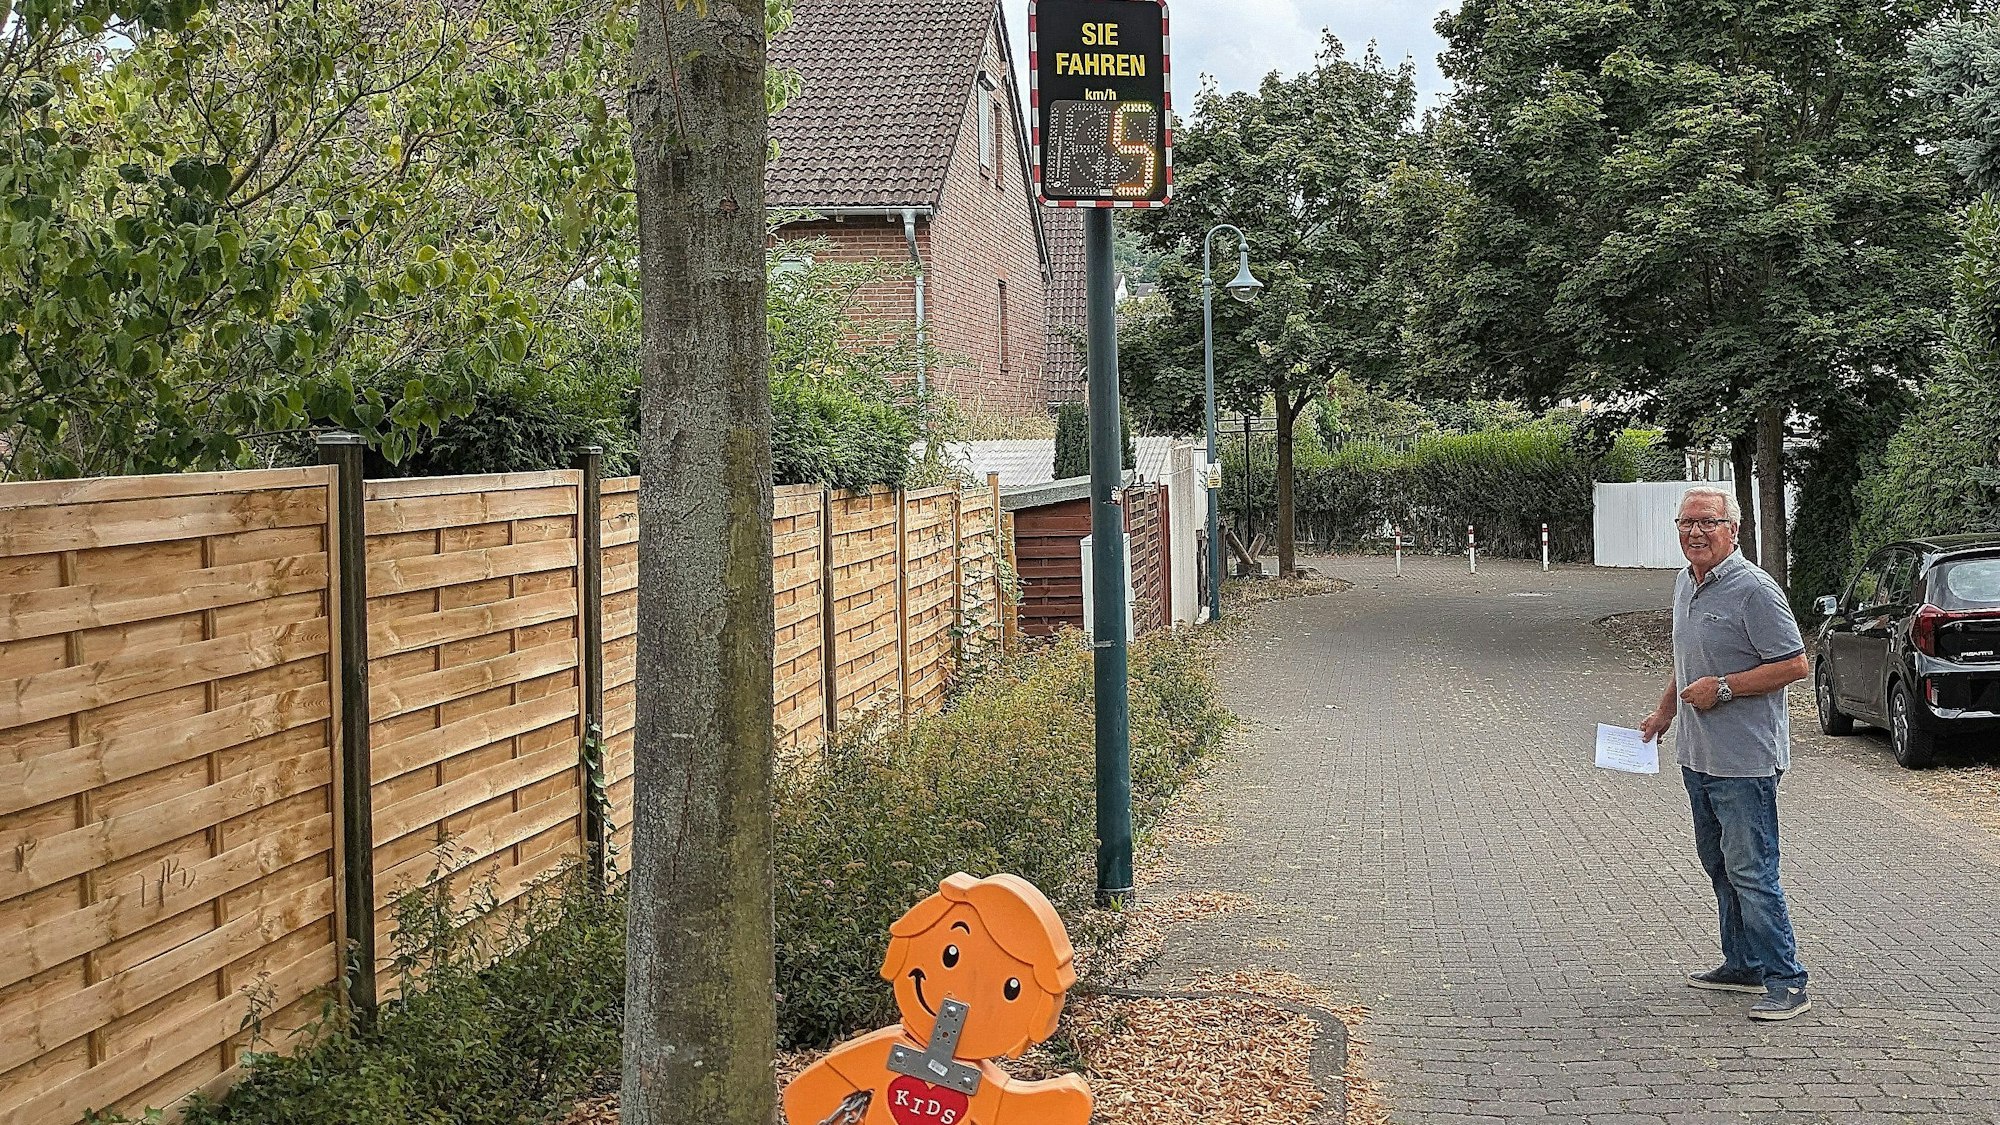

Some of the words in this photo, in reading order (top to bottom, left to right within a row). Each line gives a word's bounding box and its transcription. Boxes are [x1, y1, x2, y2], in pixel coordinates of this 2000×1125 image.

[1081, 22, 1119, 46] SIE
[1055, 53, 1146, 77] FAHREN
[1085, 88, 1117, 101] km/h
[1112, 102, 1155, 197] 5
[894, 1089, 957, 1125] KIDS
